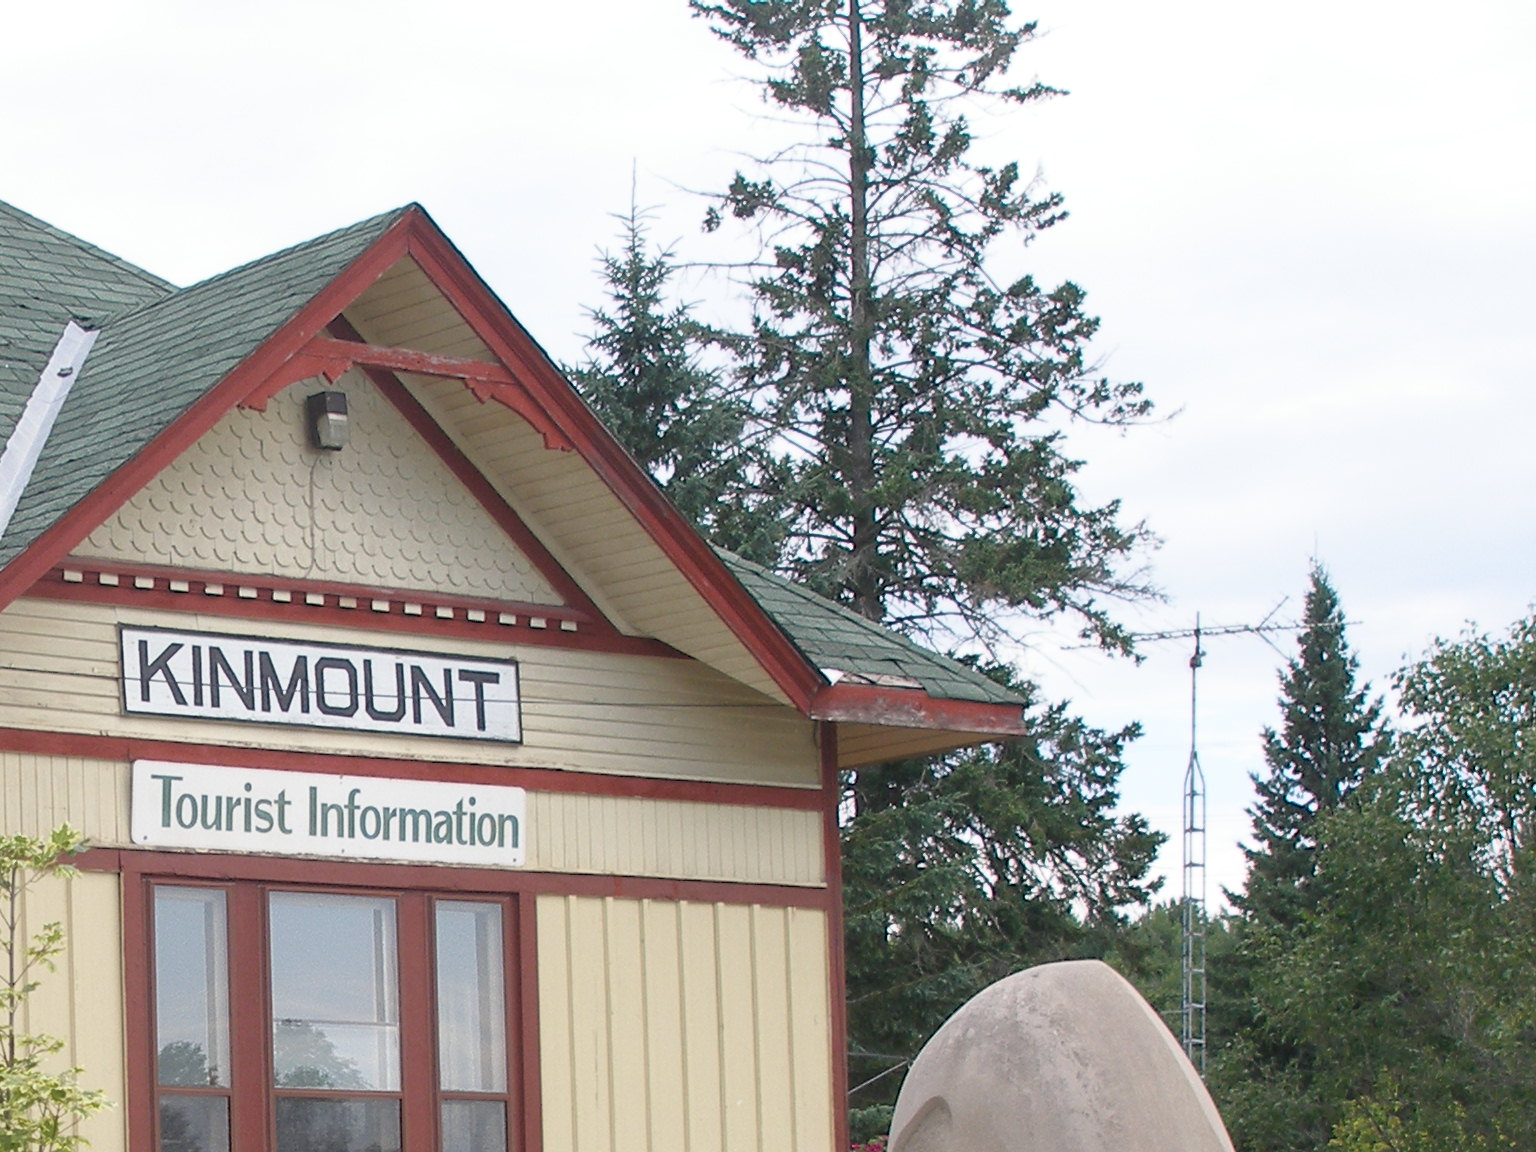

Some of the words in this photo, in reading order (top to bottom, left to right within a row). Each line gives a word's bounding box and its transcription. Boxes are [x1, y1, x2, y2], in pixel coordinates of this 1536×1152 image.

[137, 639, 501, 732] KINMOUNT
[151, 774, 293, 835] Tourist
[308, 786, 520, 849] Information
